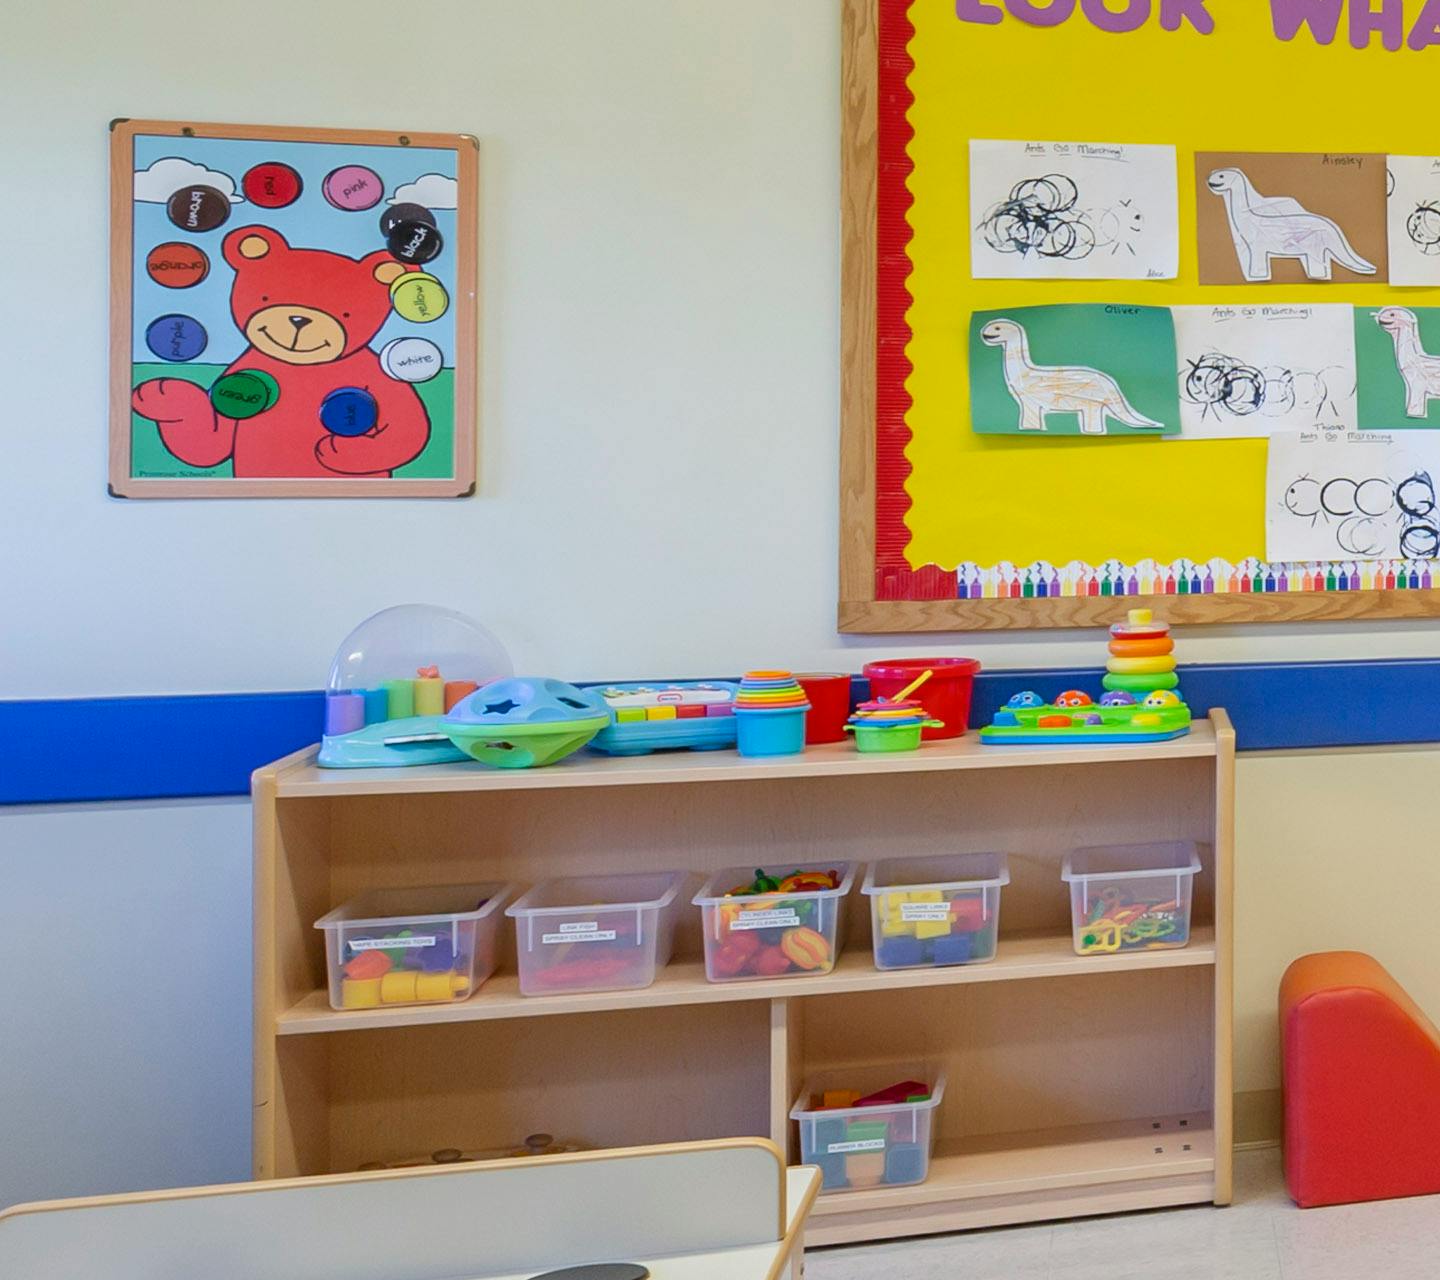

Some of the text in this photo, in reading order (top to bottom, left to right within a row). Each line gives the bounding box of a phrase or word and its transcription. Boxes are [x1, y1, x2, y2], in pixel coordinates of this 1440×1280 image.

[265, 176, 276, 195] red
[343, 179, 368, 198] pink
[187, 190, 206, 227] brown
[402, 226, 429, 259] black
[150, 260, 203, 271] orange
[414, 285, 431, 317] yellow
[1104, 304, 1142, 315] Oliver
[173, 321, 185, 358] purple
[397, 353, 435, 369] white
[218, 388, 260, 404] green
